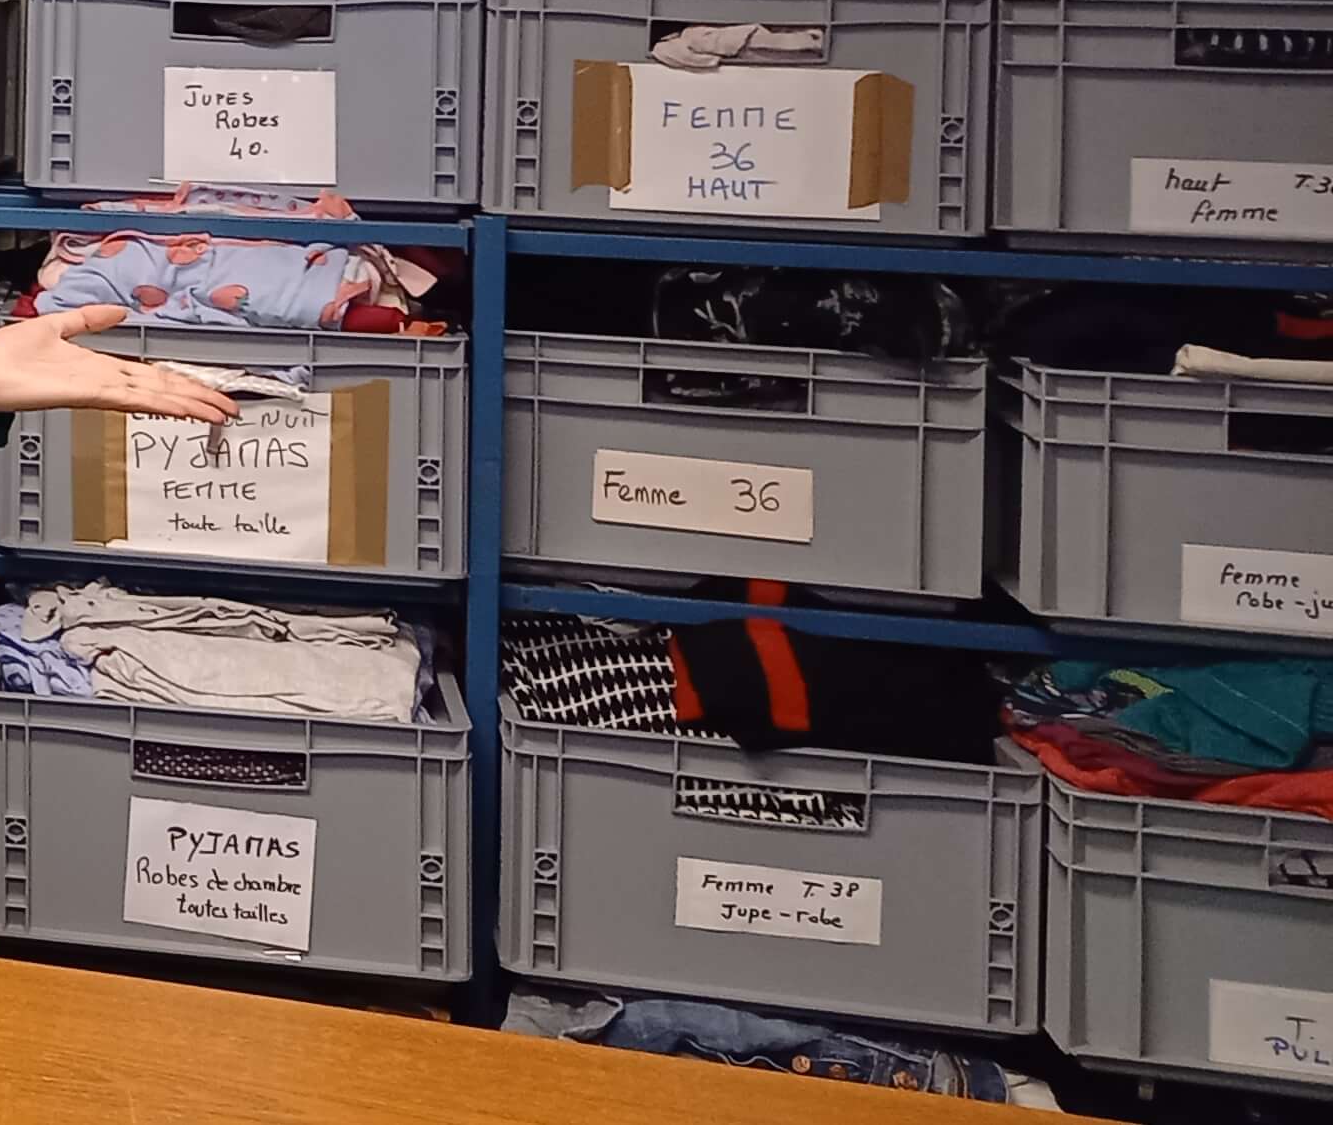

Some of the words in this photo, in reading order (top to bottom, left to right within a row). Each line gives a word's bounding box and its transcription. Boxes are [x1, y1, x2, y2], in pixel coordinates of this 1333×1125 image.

[215, 109, 279, 130] Robes
[662, 102, 798, 131] FEMME
[709, 142, 755, 172] 36
[687, 176, 781, 201] HAUT
[1164, 167, 1232, 193] haut
[1190, 199, 1279, 224] femme
[131, 431, 309, 470] PYJAMAS
[163, 480, 257, 500] FEMME
[603, 470, 688, 506] Femme
[730, 478, 781, 513] 36
[167, 512, 222, 531] toute
[235, 512, 291, 535] taille
[1220, 562, 1301, 588] femme
[167, 826, 301, 863] PYJAMAS
[136, 856, 199, 889] Robes
[206, 868, 229, 892] de
[233, 872, 302, 896] chambre
[701, 874, 774, 896] Femme
[176, 893, 228, 919] toutes
[233, 902, 289, 925] tailles
